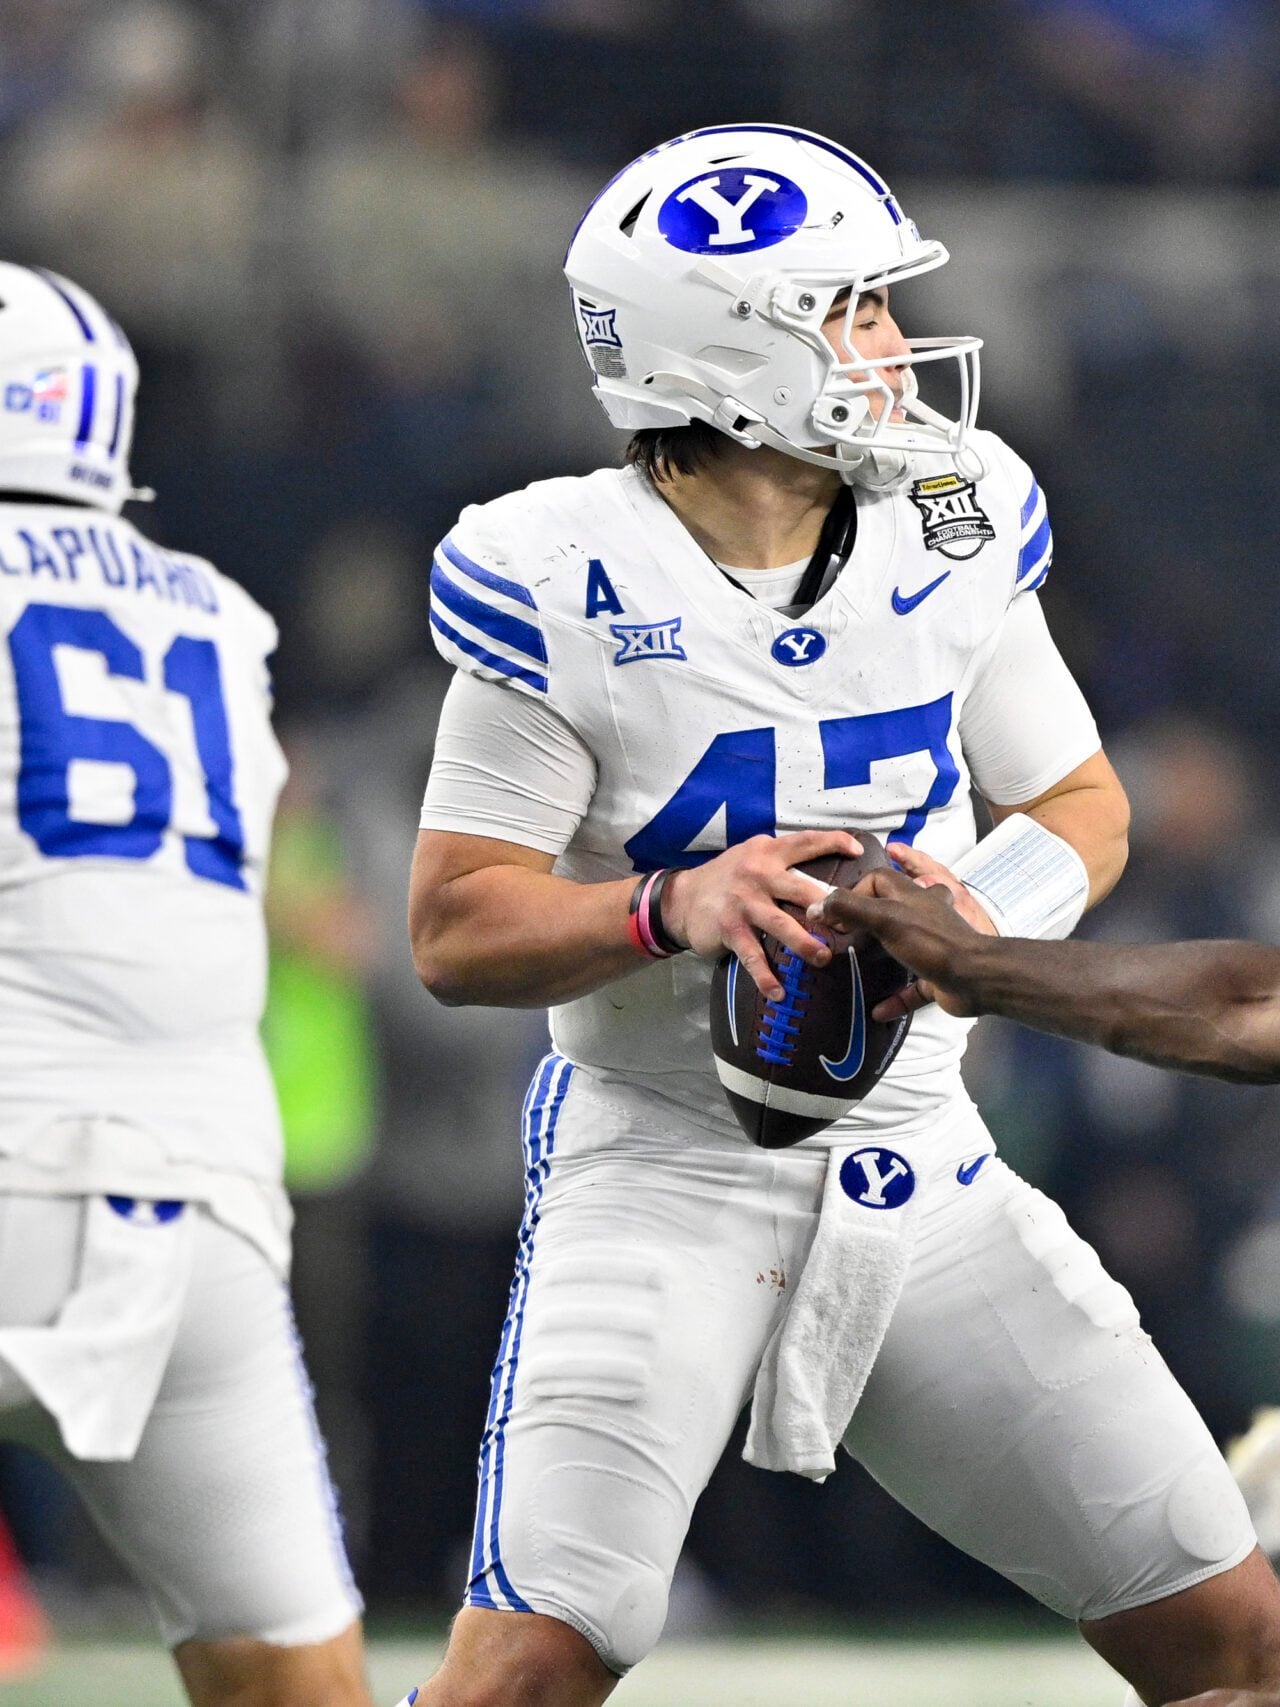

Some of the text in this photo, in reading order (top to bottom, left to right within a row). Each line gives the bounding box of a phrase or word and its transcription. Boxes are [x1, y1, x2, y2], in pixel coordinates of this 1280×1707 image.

[676, 174, 780, 246] Y
[580, 310, 621, 347] XII
[585, 558, 626, 619] A
[613, 619, 686, 664] XII
[779, 633, 816, 661] Y
[7, 603, 251, 892] 61
[624, 691, 960, 873] 47
[852, 1151, 911, 1206] Y
